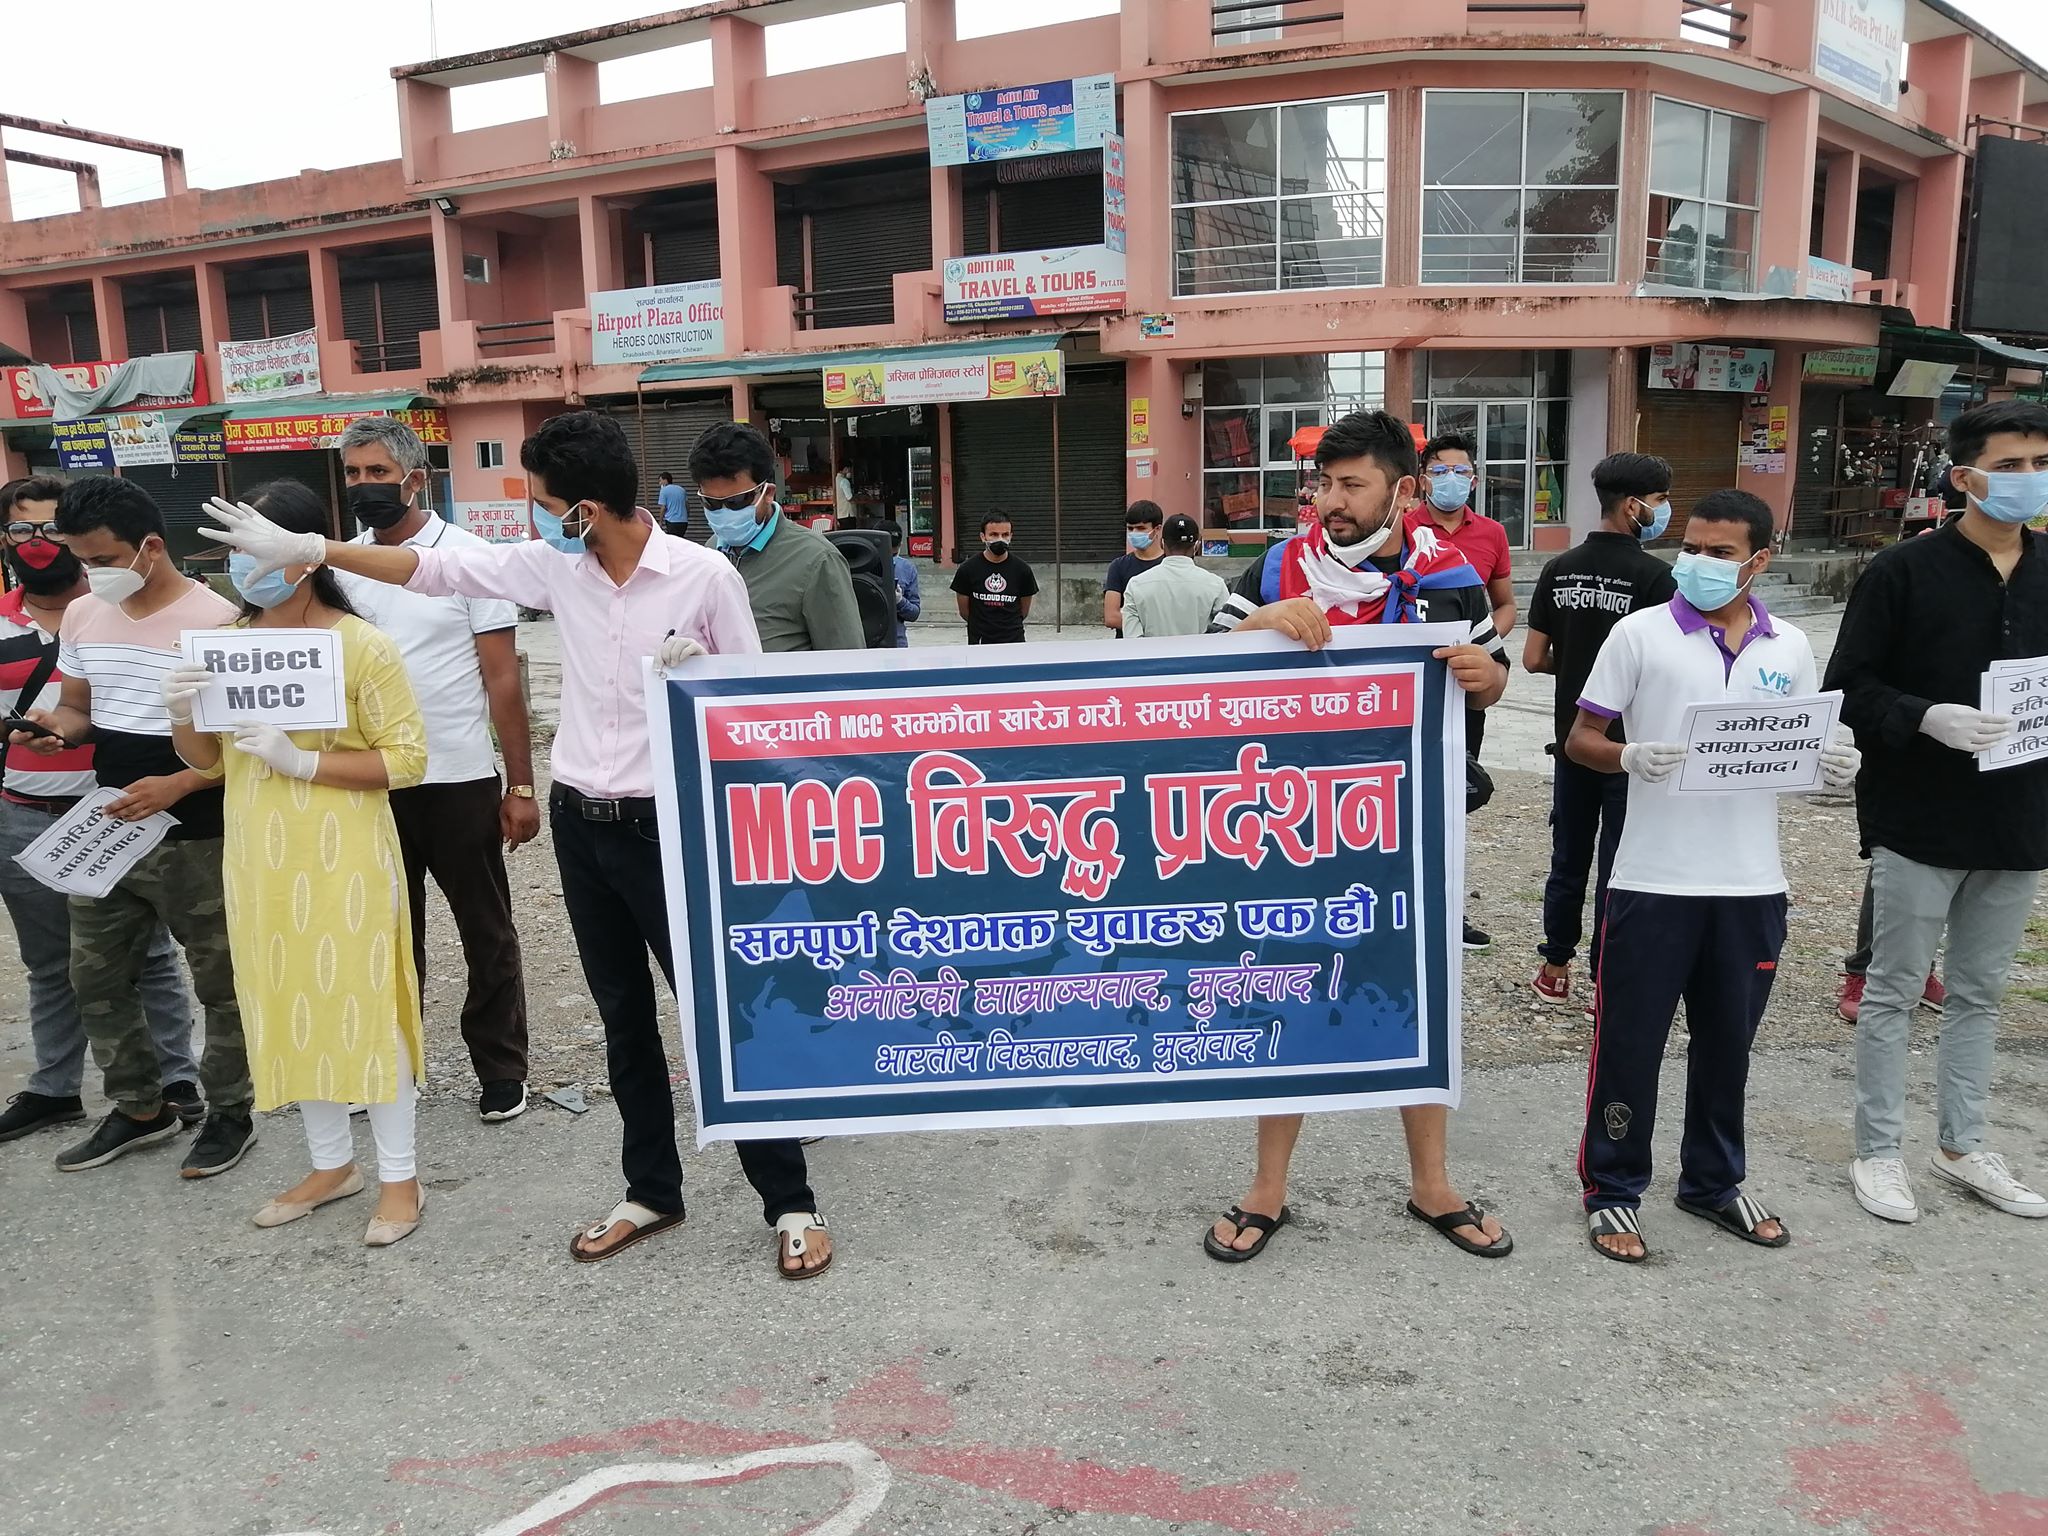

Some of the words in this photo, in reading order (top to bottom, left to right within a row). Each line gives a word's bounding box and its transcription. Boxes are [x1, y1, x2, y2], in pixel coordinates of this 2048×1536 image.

[996, 92, 1022, 105] Aditi
[1023, 89, 1040, 102] Air
[966, 109, 1002, 127] Travel
[1003, 109, 1013, 122] &
[1013, 104, 1048, 121] Tours
[967, 261, 994, 274] ADITI
[996, 258, 1015, 272] AIR
[959, 277, 1021, 300] TRAVEL
[1025, 275, 1039, 292] &
[1041, 270, 1097, 292] TOURS
[597, 311, 642, 335] Airport
[647, 307, 683, 327] Plaza
[688, 302, 724, 323] Office
[612, 335, 646, 349] HEROES
[648, 329, 713, 346] CONSTRUCTION
[224, 421, 241, 440] प्रेम
[243, 422, 272, 438] खाजा
[275, 421, 291, 436] घर
[294, 419, 318, 435] एण्ड
[468, 507, 480, 522] प्रेम
[482, 510, 501, 522] खाजा
[504, 509, 516, 521] घर
[203, 648, 322, 675] Reject
[226, 683, 305, 710] MCC
[2009, 677, 2033, 693] यो
[726, 711, 832, 749] राष्ट्रघाती
[840, 713, 884, 740] MCC
[891, 703, 992, 738] सम्झौता
[998, 699, 1071, 730] खारेज
[1134, 692, 1212, 729] सम्पूर्ण
[1309, 692, 1351, 718] एक
[1715, 713, 1812, 732] अमेरिकी
[1694, 736, 1823, 754] साम्राज्यवाद
[724, 776, 885, 886] MCC
[729, 910, 881, 969] सम्पूर्ण
[887, 906, 1060, 959] देशभक्त
[1234, 897, 1318, 940] एक
[823, 965, 970, 1021] अमेरिकी
[974, 969, 1172, 1016] साम्राज्यवाद,
[1187, 950, 1322, 1019] मुर्दावाद
[875, 1030, 983, 1076] भारतीय
[987, 1027, 1141, 1072] विस्तारवाद,
[1152, 1019, 1263, 1075] मुर्दावाद
